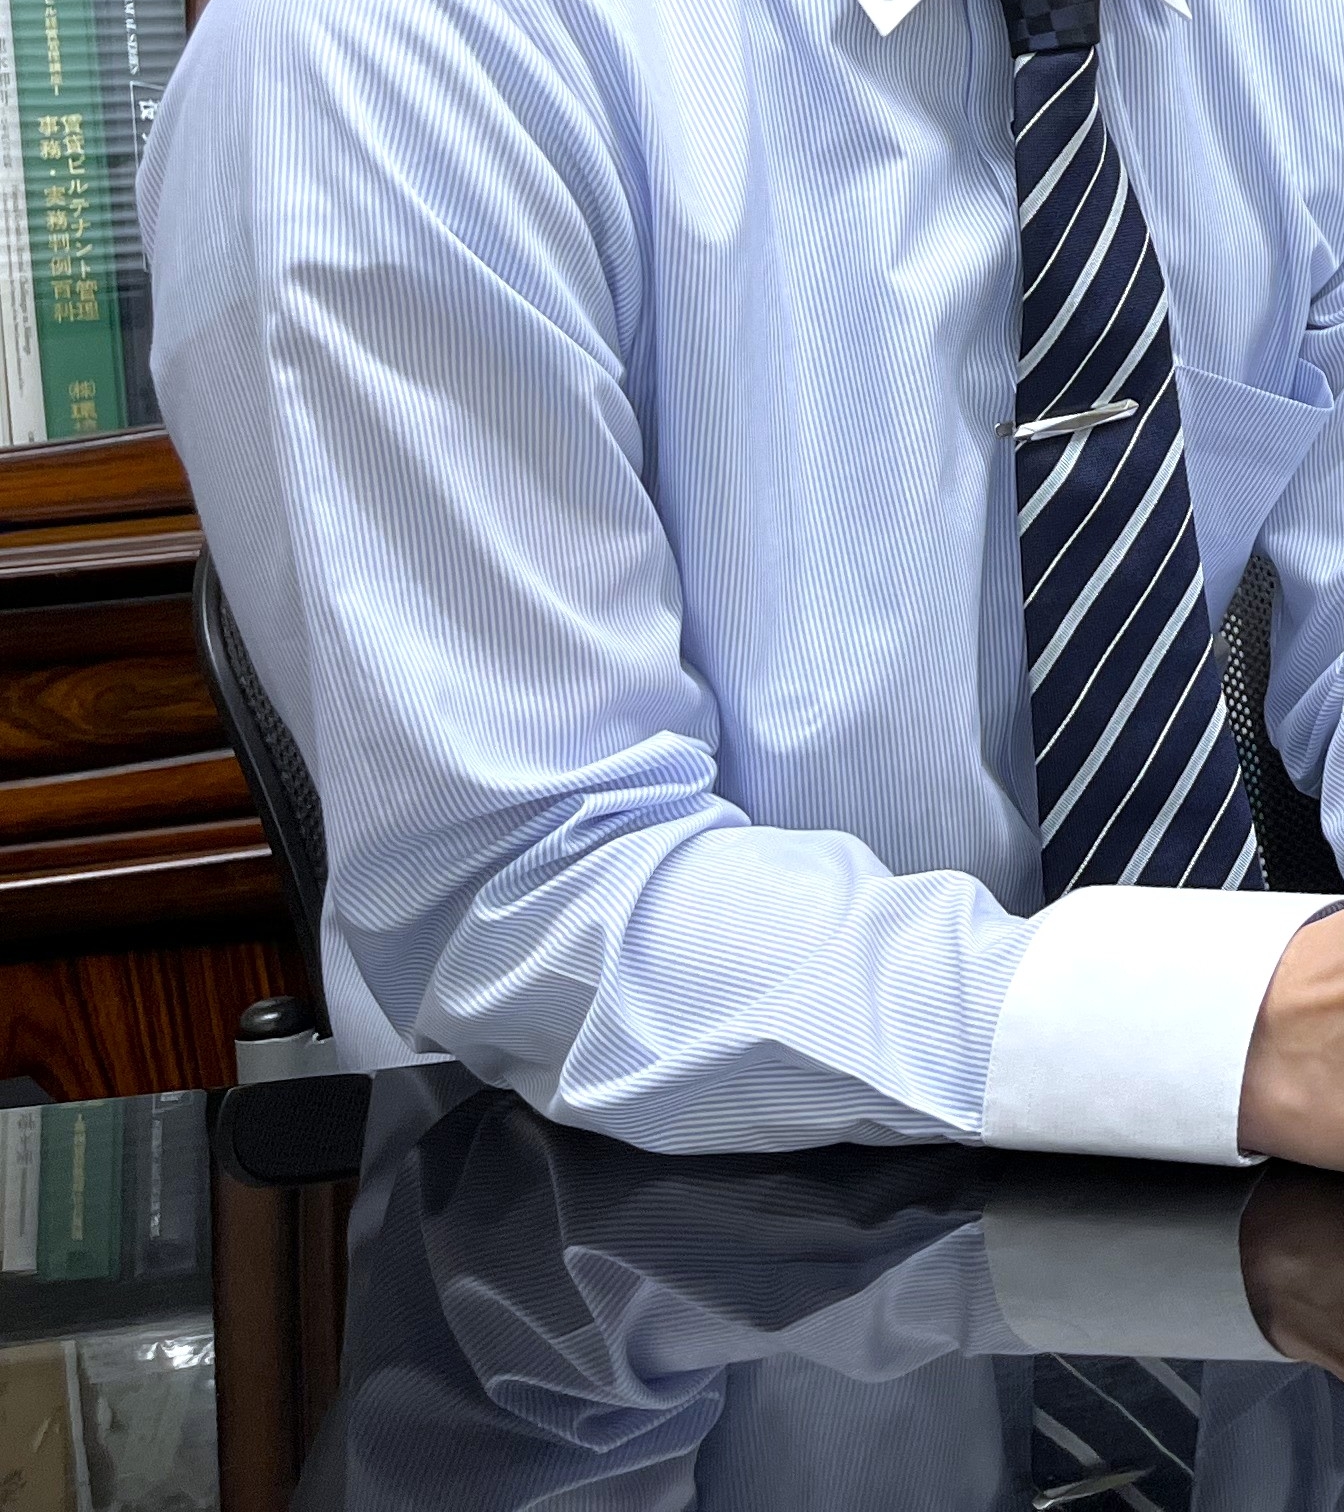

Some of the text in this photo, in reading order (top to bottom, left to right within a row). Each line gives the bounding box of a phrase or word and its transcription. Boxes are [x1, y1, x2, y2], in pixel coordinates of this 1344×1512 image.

[61, 113, 100, 321] 賃貸ビルテナント管理
